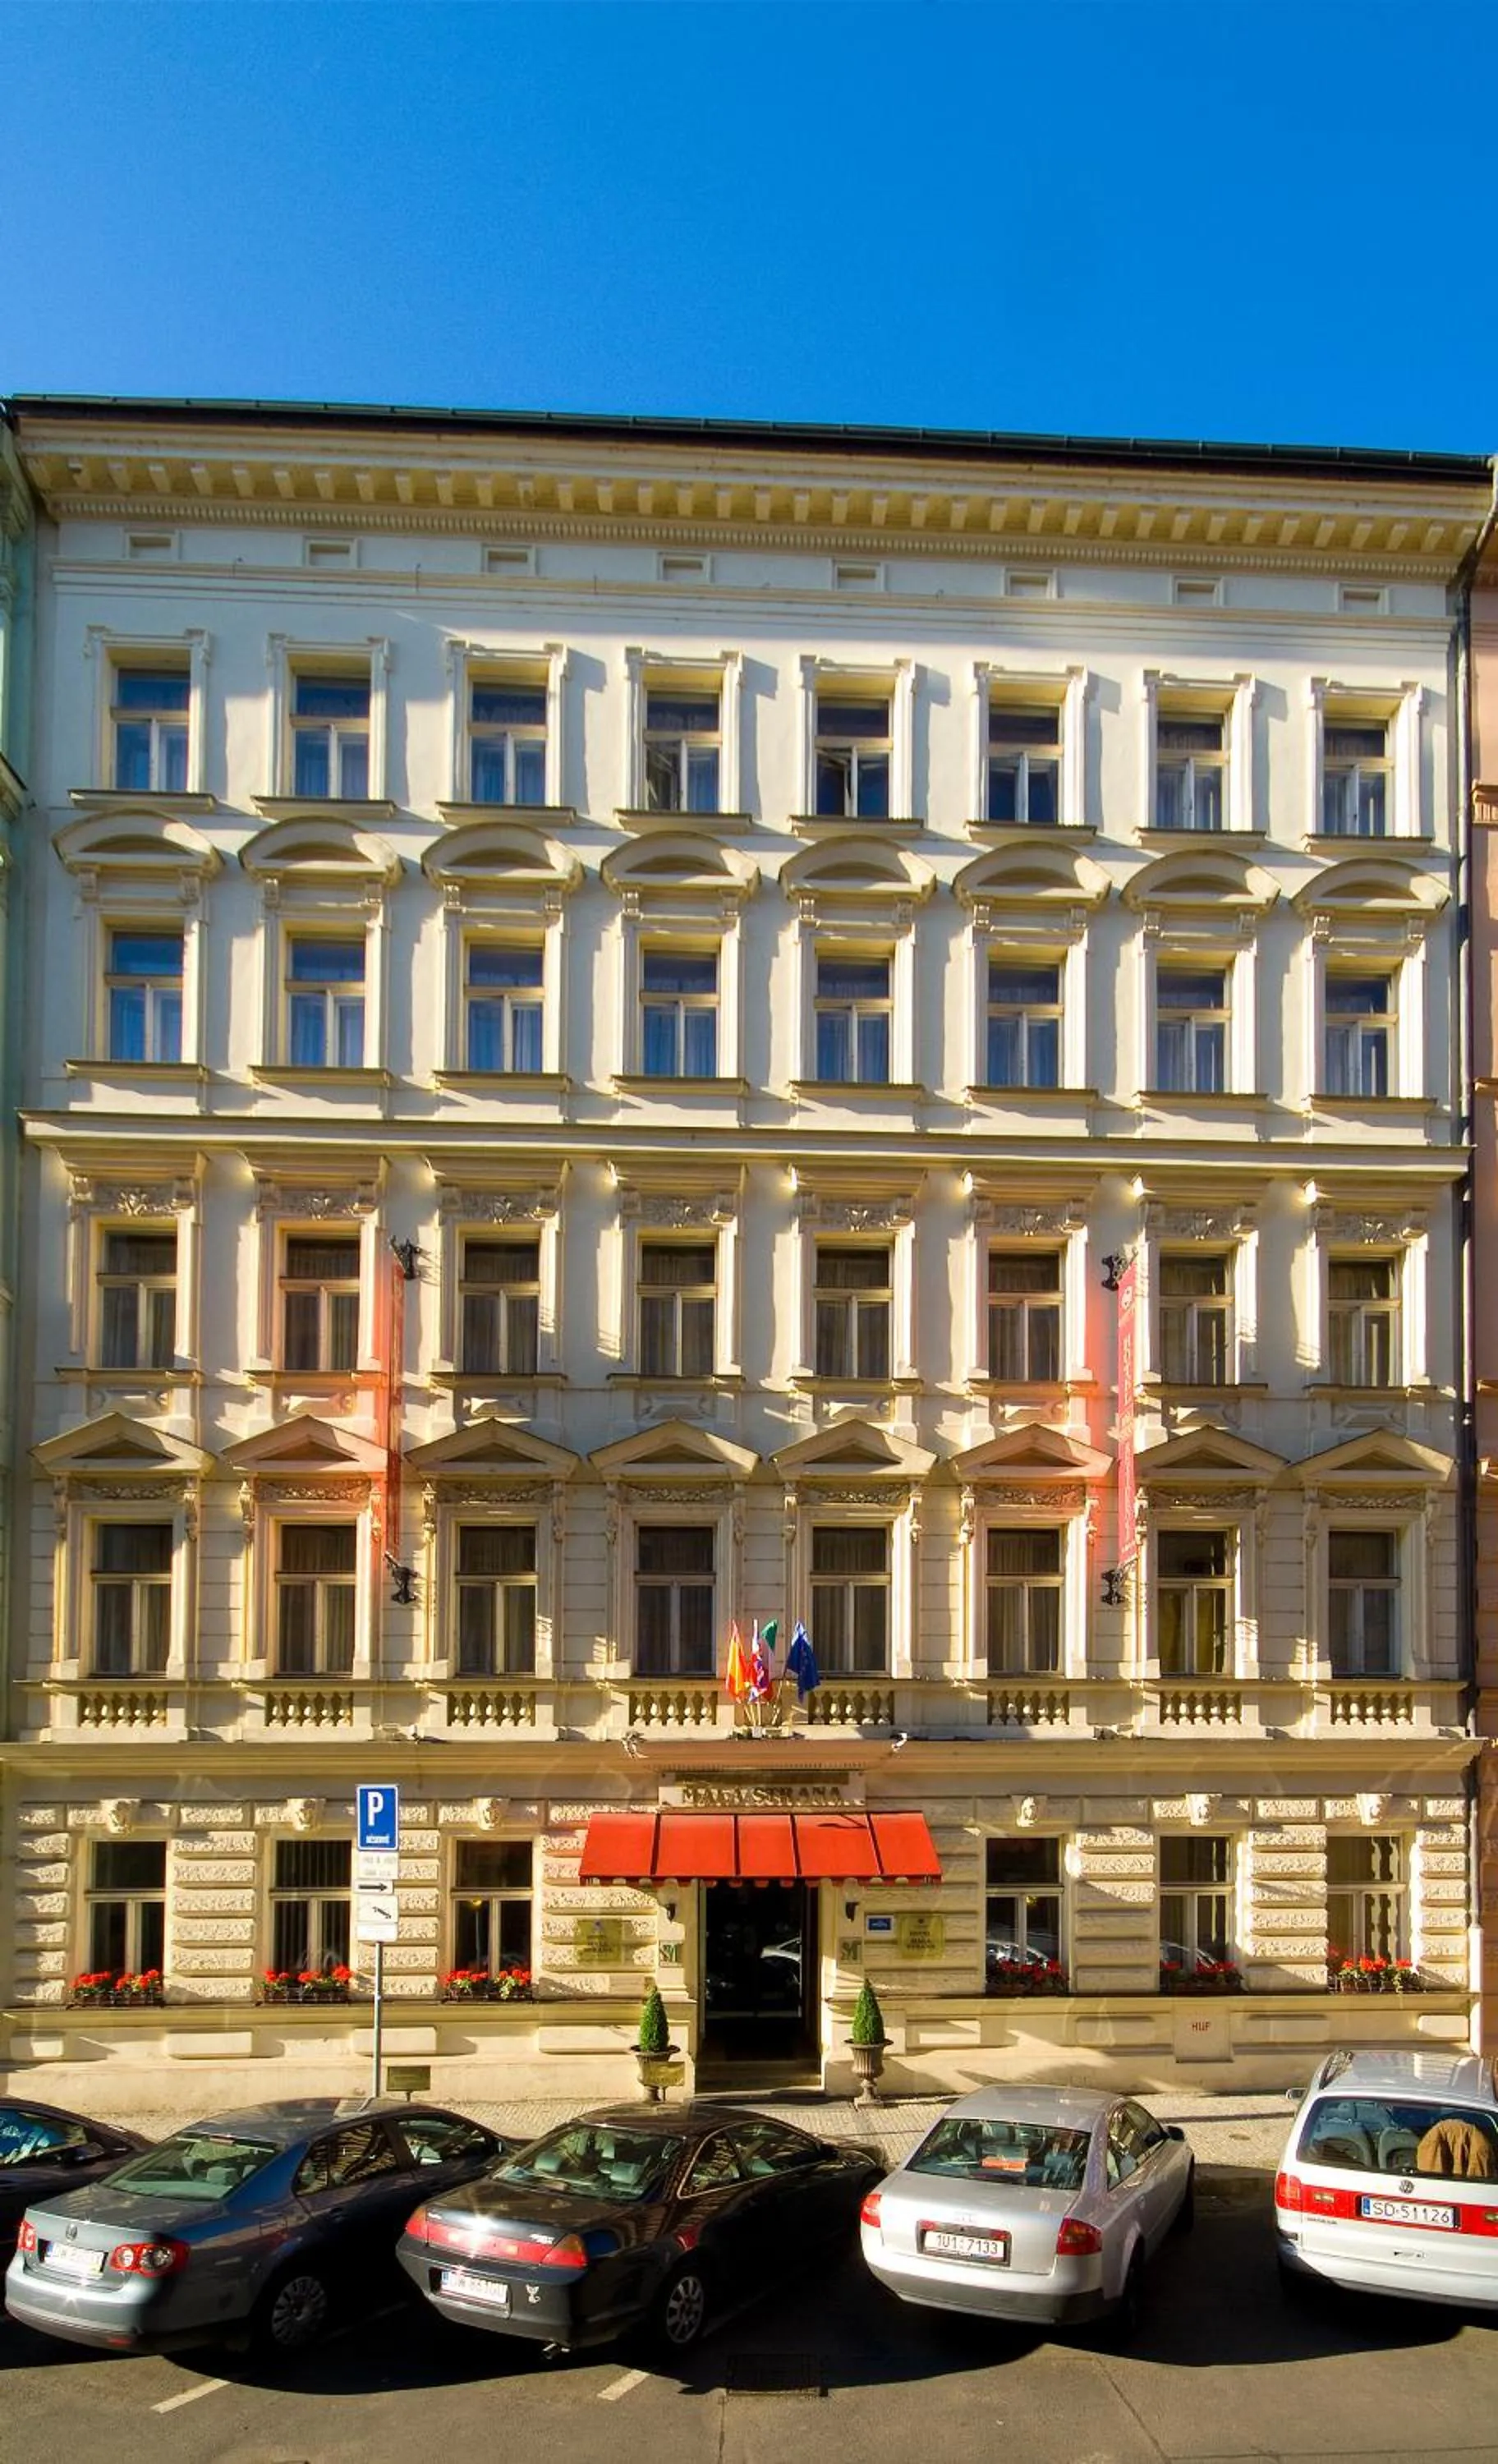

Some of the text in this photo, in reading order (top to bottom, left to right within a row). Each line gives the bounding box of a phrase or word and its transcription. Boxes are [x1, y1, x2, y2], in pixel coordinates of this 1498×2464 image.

[367, 1791, 384, 1827] P
[1372, 2202, 1450, 2224] SD 51126
